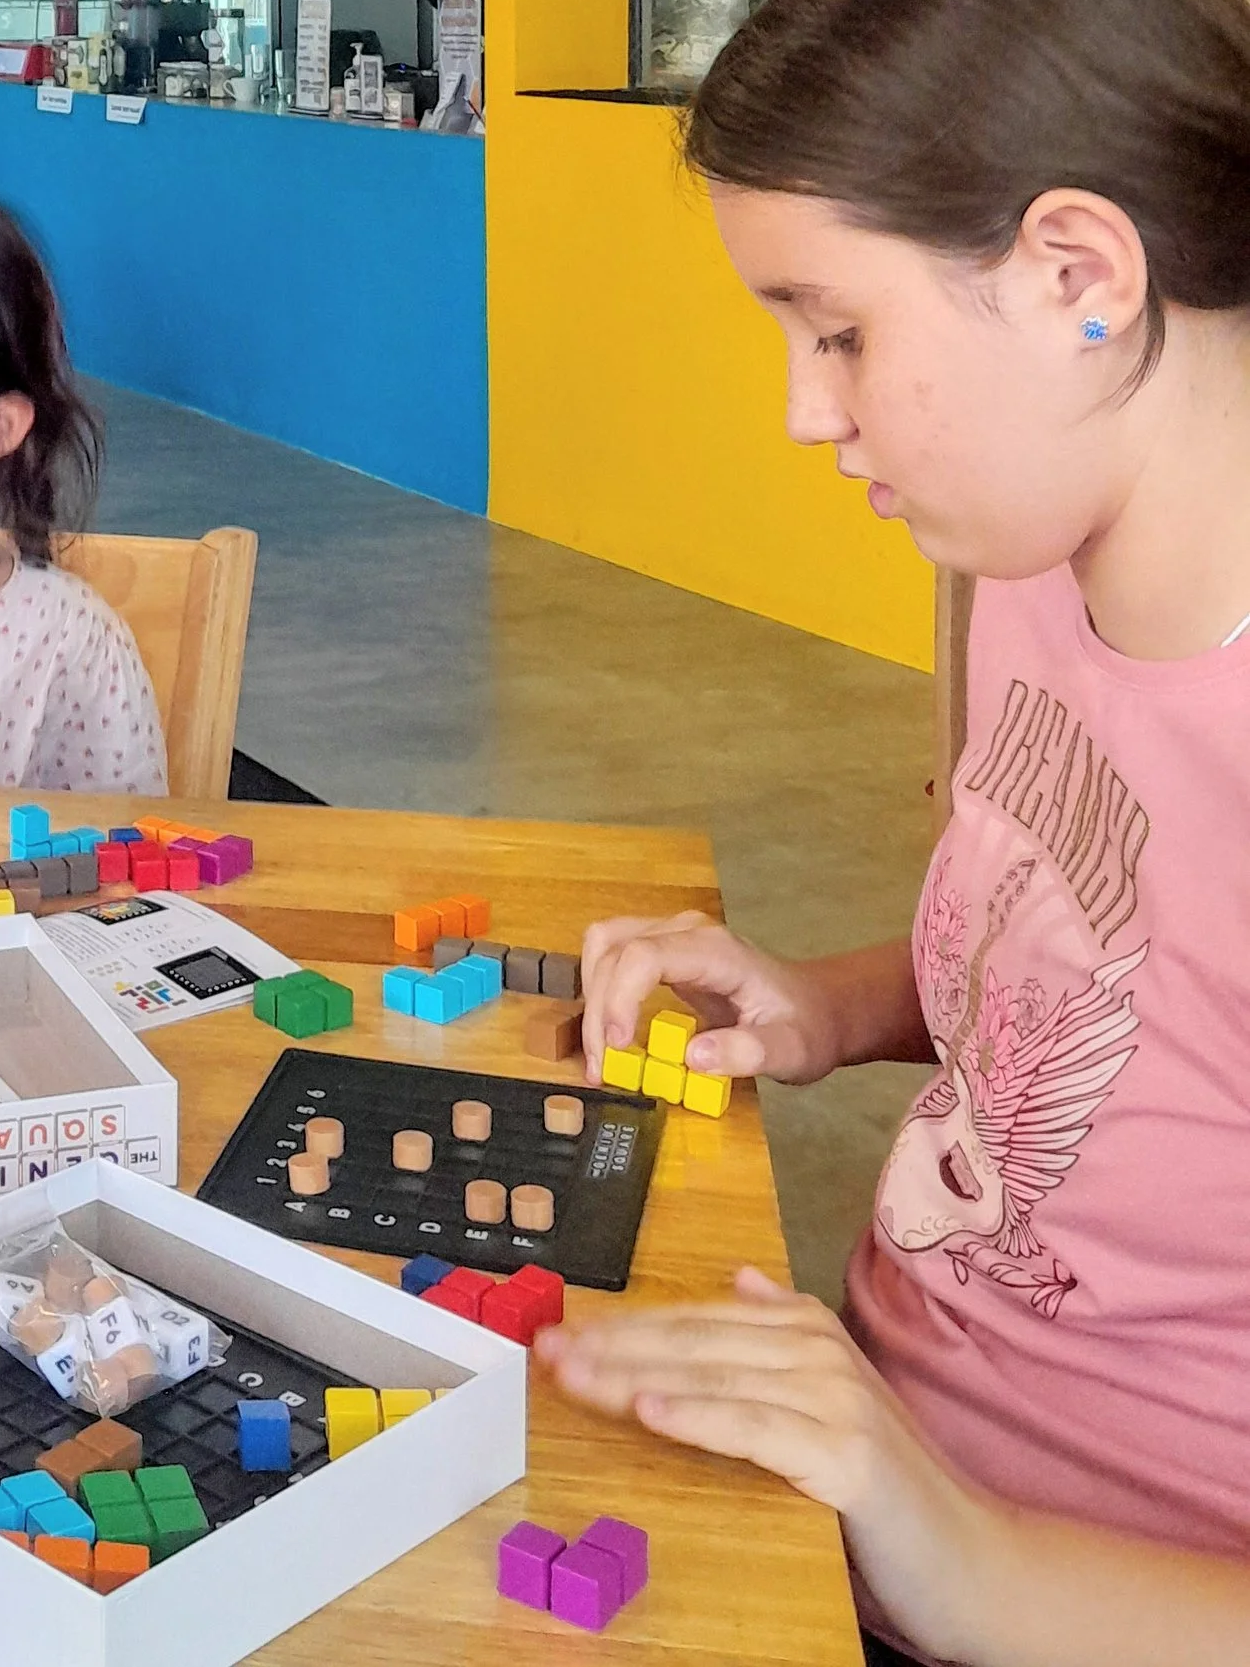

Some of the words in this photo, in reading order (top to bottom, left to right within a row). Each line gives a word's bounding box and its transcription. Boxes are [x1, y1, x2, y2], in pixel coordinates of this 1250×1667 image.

[964, 678, 1151, 950] DREAMER
[306, 1088, 327, 1099] 6
[296, 1105, 317, 1115] 5
[276, 1139, 298, 1150] 3
[592, 1123, 616, 1169] GENIUS
[611, 1126, 635, 1171] SQUARE
[130, 1153, 159, 1165] THE
[266, 1157, 288, 1168] 2
[283, 1201, 307, 1213] A
[327, 1207, 351, 1220] B
[373, 1213, 397, 1227] C
[418, 1221, 442, 1234] D
[464, 1229, 489, 1241] E
[511, 1235, 534, 1248] F
[99, 1311, 121, 1345] F6
[187, 1335, 201, 1367] F3
[237, 1372, 264, 1387] C
